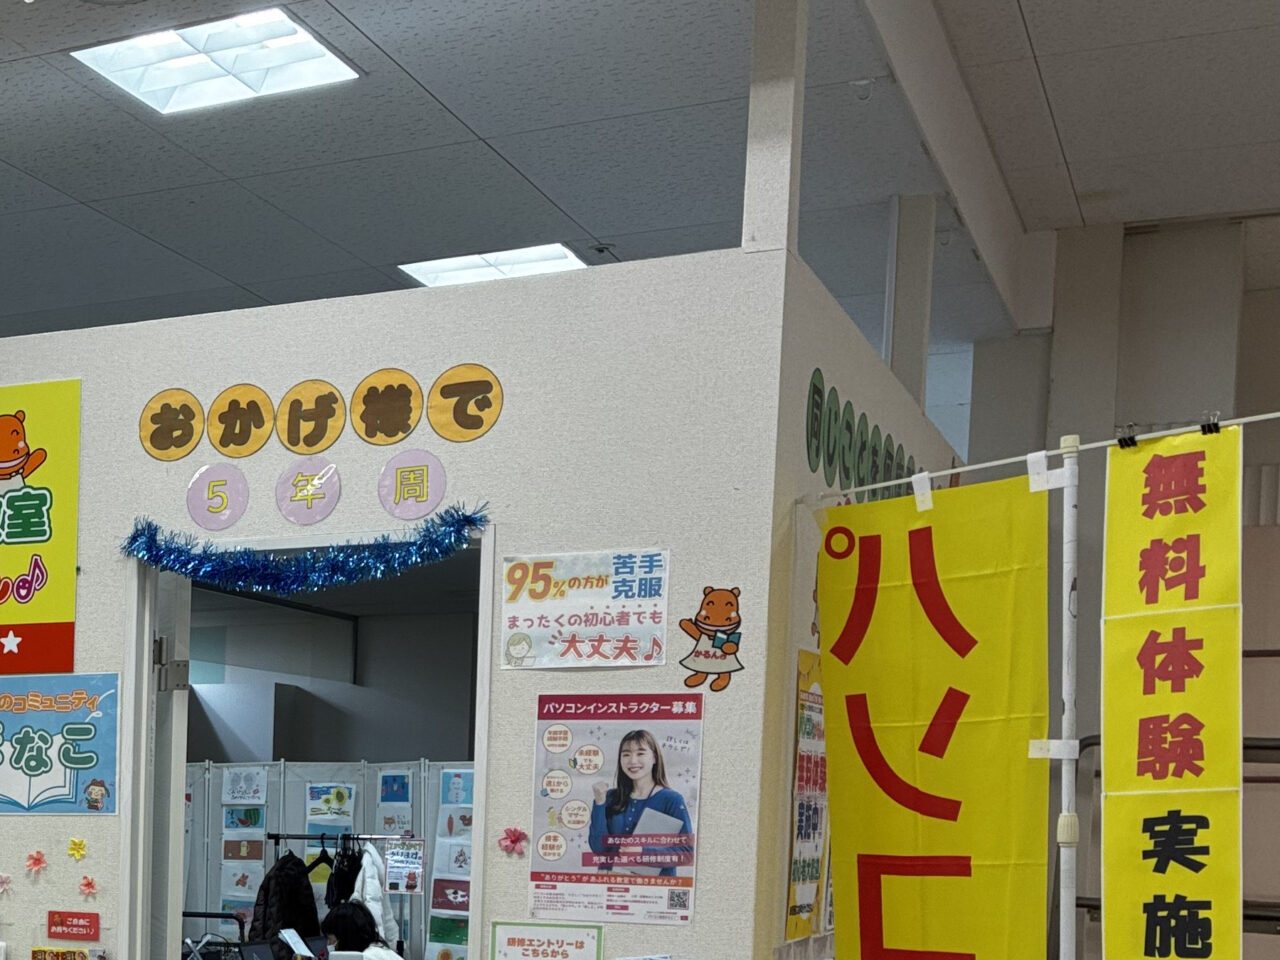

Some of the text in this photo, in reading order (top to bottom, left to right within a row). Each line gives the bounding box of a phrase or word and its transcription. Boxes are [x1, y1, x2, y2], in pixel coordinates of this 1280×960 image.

[207, 465, 430, 514] 5年周
[612, 553, 664, 576] 苦手
[611, 576, 664, 600] 克服
[507, 609, 663, 630] まったくの初心者でも
[558, 633, 640, 661] 大丈夫
[542, 700, 698, 715] パソコンインストラクター募集
[607, 836, 688, 844] あなたのスキルに合わせて
[506, 937, 585, 949] 研修エントリーは
[521, 948, 570, 959] こちらから
